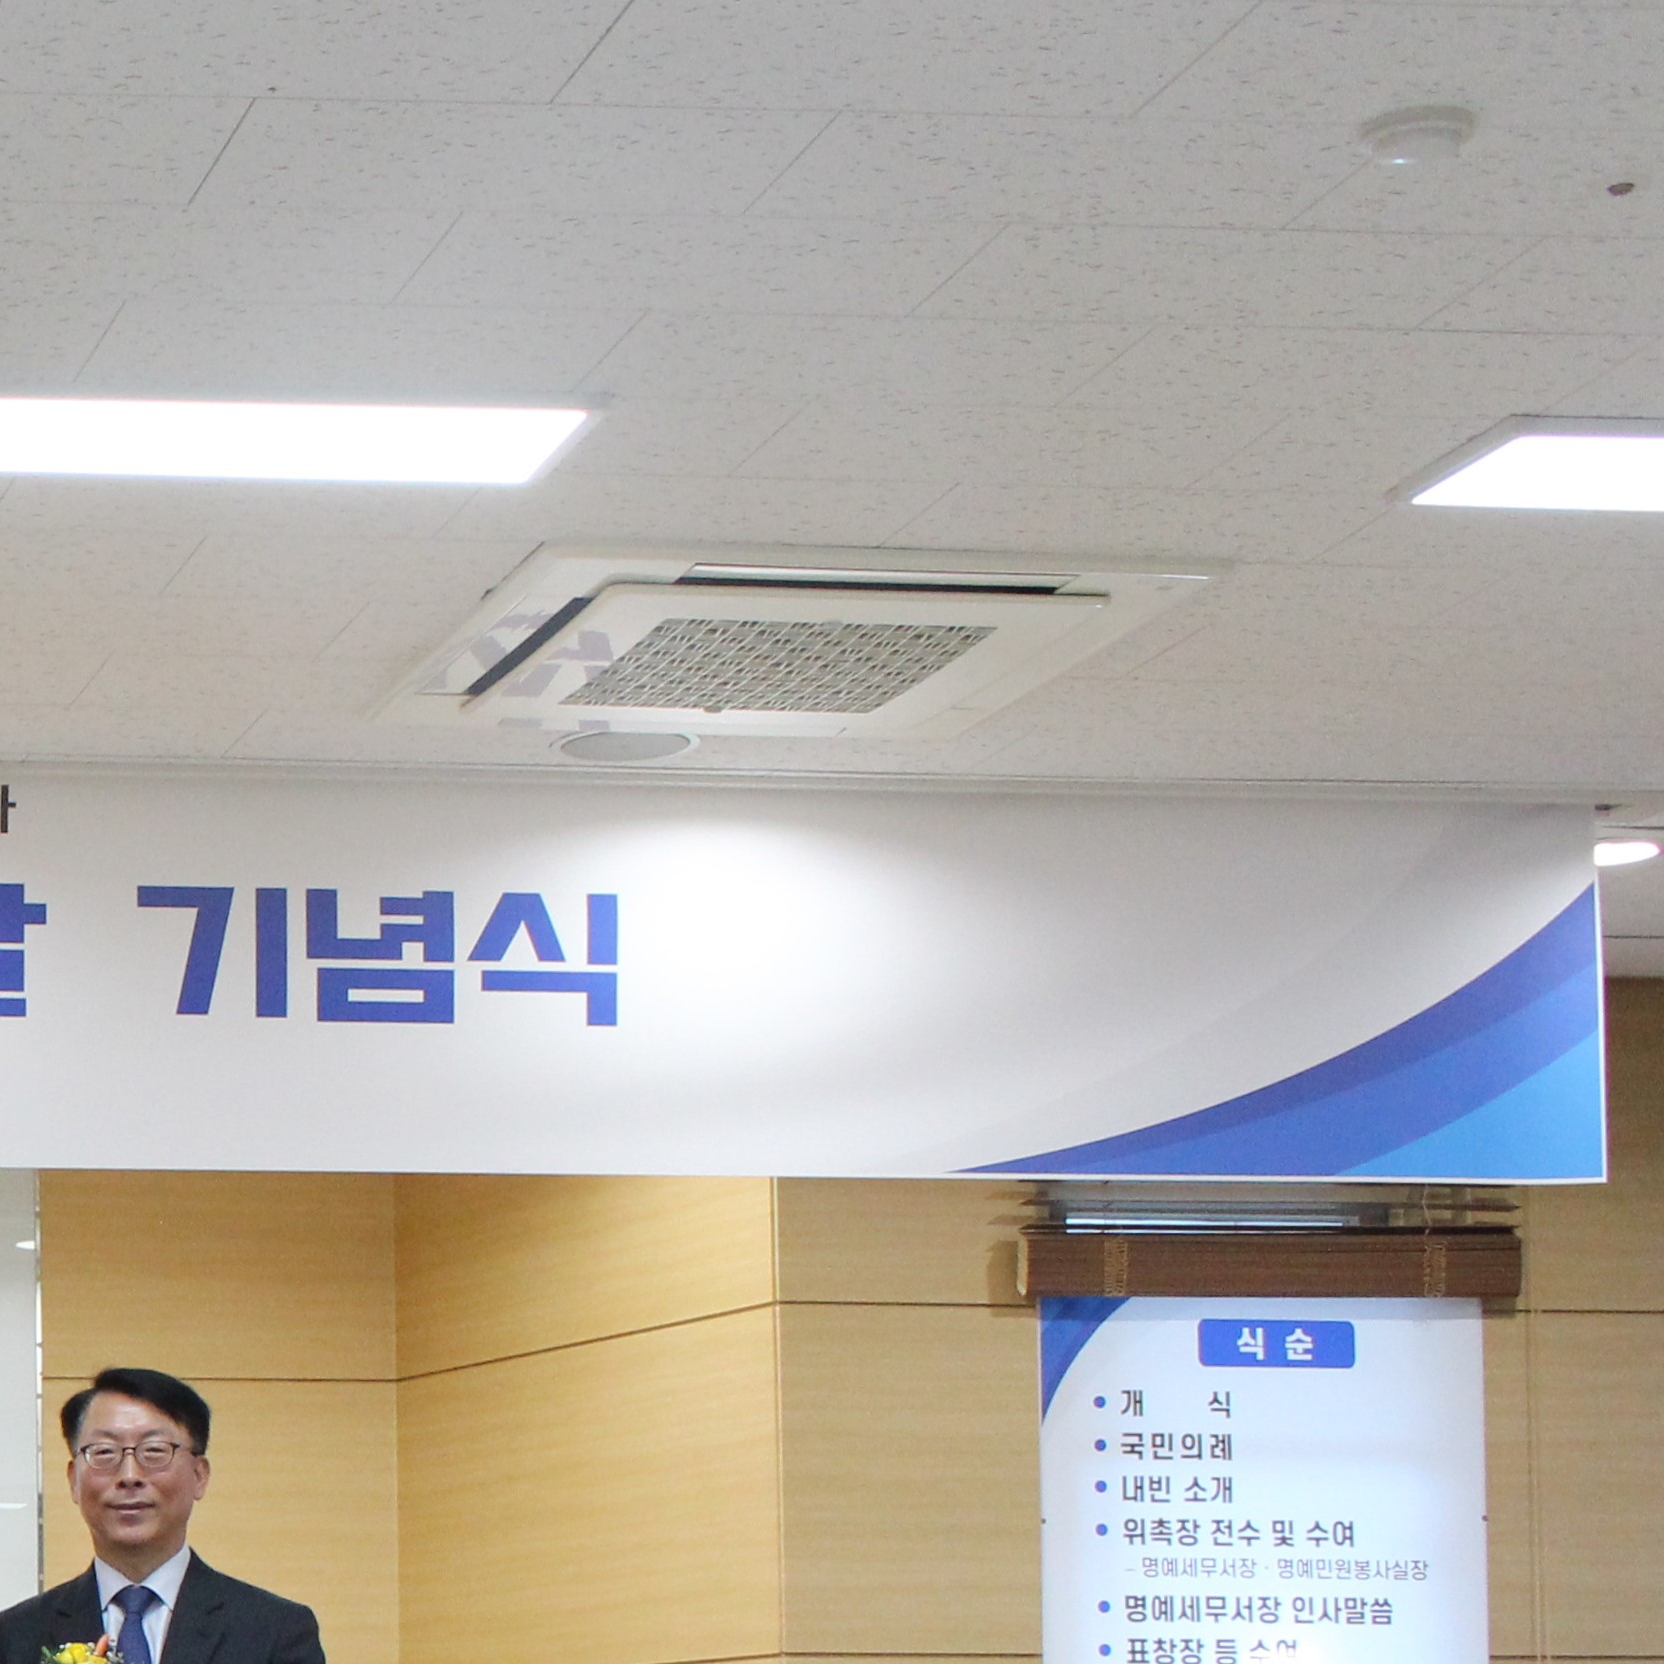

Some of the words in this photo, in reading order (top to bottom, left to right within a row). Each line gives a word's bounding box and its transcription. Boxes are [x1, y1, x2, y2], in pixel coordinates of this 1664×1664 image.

[141, 886, 618, 1025] 기념식
[1121, 1433, 1232, 1460] 국민의례
[1123, 1476, 1171, 1503] 내빈
[1185, 1476, 1232, 1503] 소개
[1123, 1518, 1201, 1546] 위촉장
[1212, 1519, 1261, 1546] 전수
[1272, 1520, 1294, 1547] 및
[1307, 1521, 1354, 1547] 수여
[1142, 1557, 1257, 1579] 명예세무서장
[1278, 1558, 1430, 1581] 명예민원봉사실장
[1125, 1595, 1282, 1624] 명예세무서장
[1293, 1597, 1393, 1625] 인사말씀
